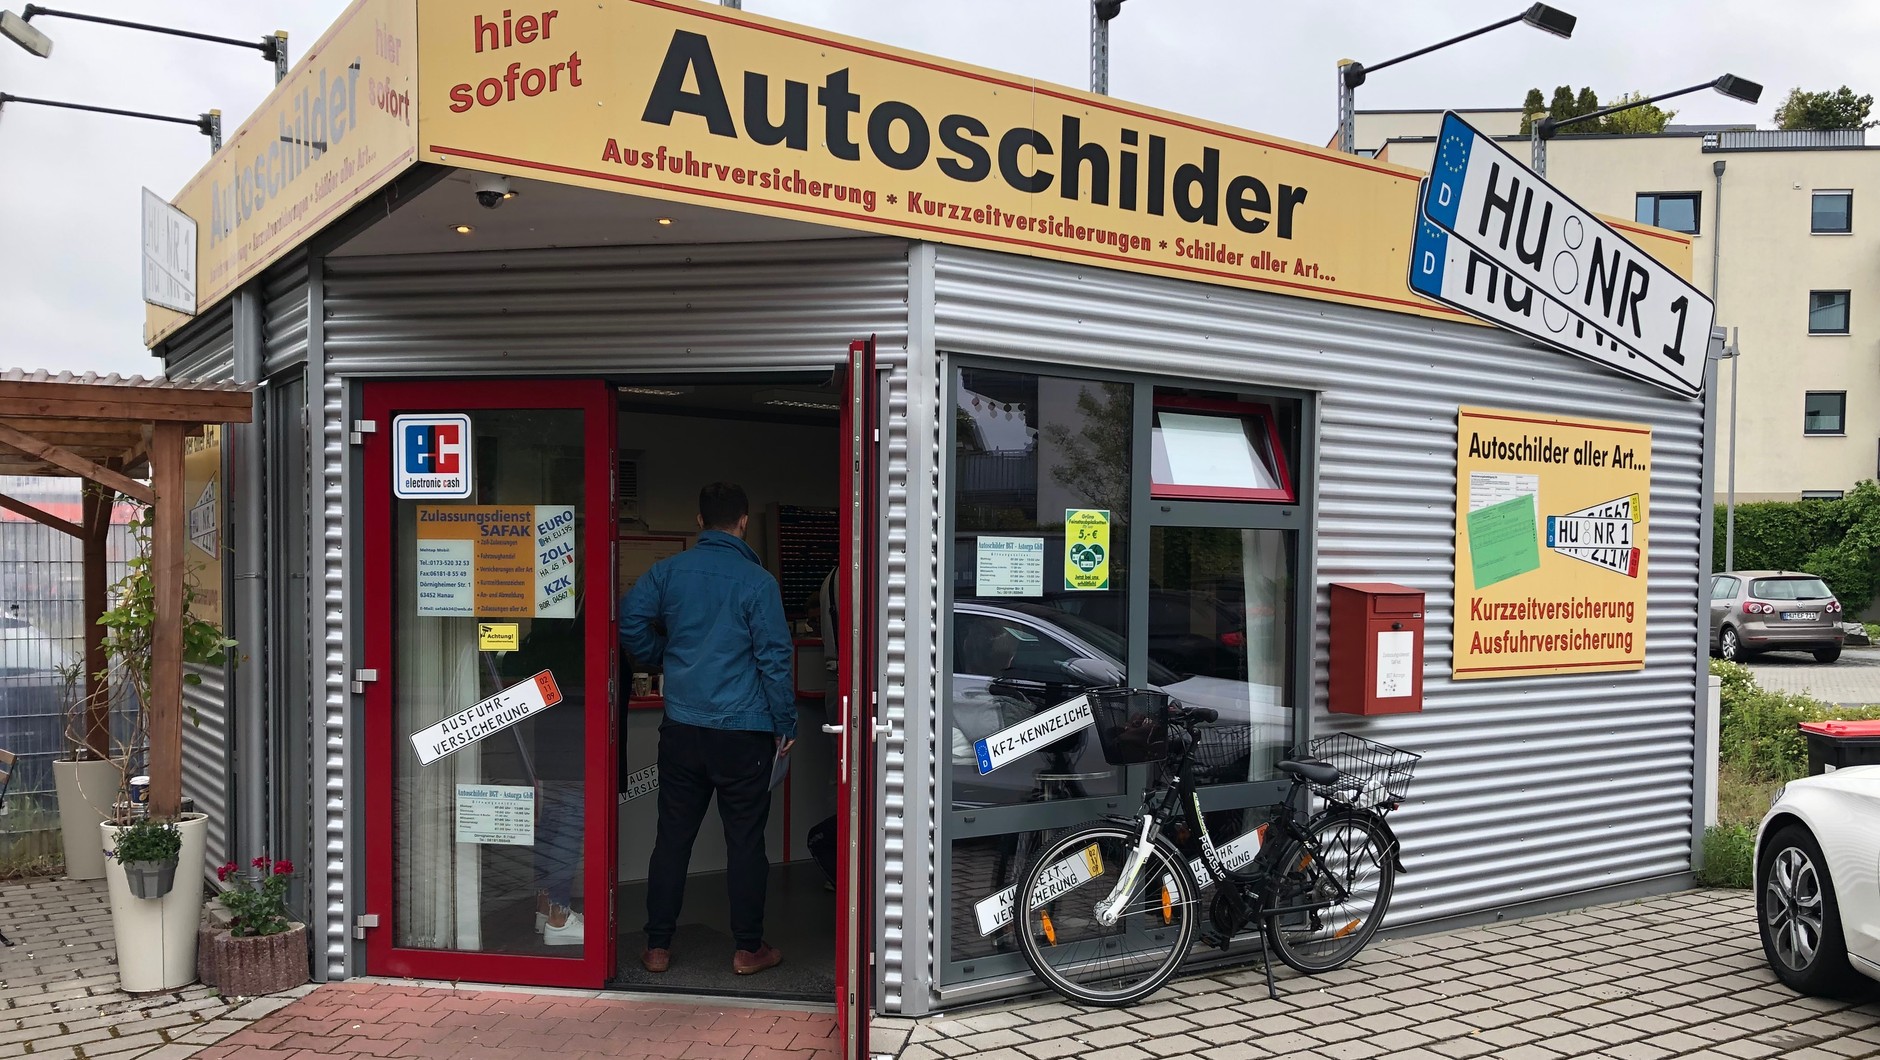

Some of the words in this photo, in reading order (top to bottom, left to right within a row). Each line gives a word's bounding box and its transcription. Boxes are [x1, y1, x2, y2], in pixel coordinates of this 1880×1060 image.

[375, 19, 401, 66] hier
[474, 9, 559, 53] hier
[449, 51, 582, 113] sofort
[368, 76, 410, 127] sofort
[641, 28, 1308, 240] Autoschilder
[210, 56, 361, 250] Autoschilder
[1438, 182, 1451, 207] D
[601, 138, 877, 212] Ausfuhrversicherung
[907, 191, 1151, 253] Kurzzeitversicherungen
[1175, 237, 1244, 266] Schilder
[1250, 251, 1287, 273] aller
[1293, 258, 1336, 282] Art...
[1423, 251, 1435, 275] D
[1478, 161, 1553, 272] HU
[1584, 236, 1650, 338] NR
[1662, 295, 1689, 366] 1
[1468, 432, 1569, 464] Autoschilder
[1573, 440, 1608, 467] aller
[1612, 444, 1646, 471] Art...
[405, 477, 441, 488] electronic
[443, 478, 460, 488] cash
[420, 510, 531, 525] Zulassungsdienst
[1588, 501, 1630, 518] 567
[480, 525, 531, 537] SAFAK
[537, 510, 573, 535] EURO
[1092, 530, 1098, 539] €
[1559, 520, 1578, 543] HU
[1594, 522, 1614, 544] NR
[1621, 523, 1629, 544] 1
[539, 542, 573, 565] ZOLL
[544, 575, 572, 596] KZK
[1470, 597, 1634, 623] Kurzzeitversicherung
[1470, 628, 1633, 654] Ausfuhrversicherung
[539, 676, 548, 685] 02
[543, 684, 552, 692] 11
[546, 692, 555, 701] 09
[441, 696, 510, 734] AUSFUHR-
[433, 702, 530, 755] VERSICHERUNG
[992, 703, 1093, 758] KFZ-KENNZEICHE
[982, 760, 989, 768] D
[1199, 835, 1227, 882] PEGASUS
